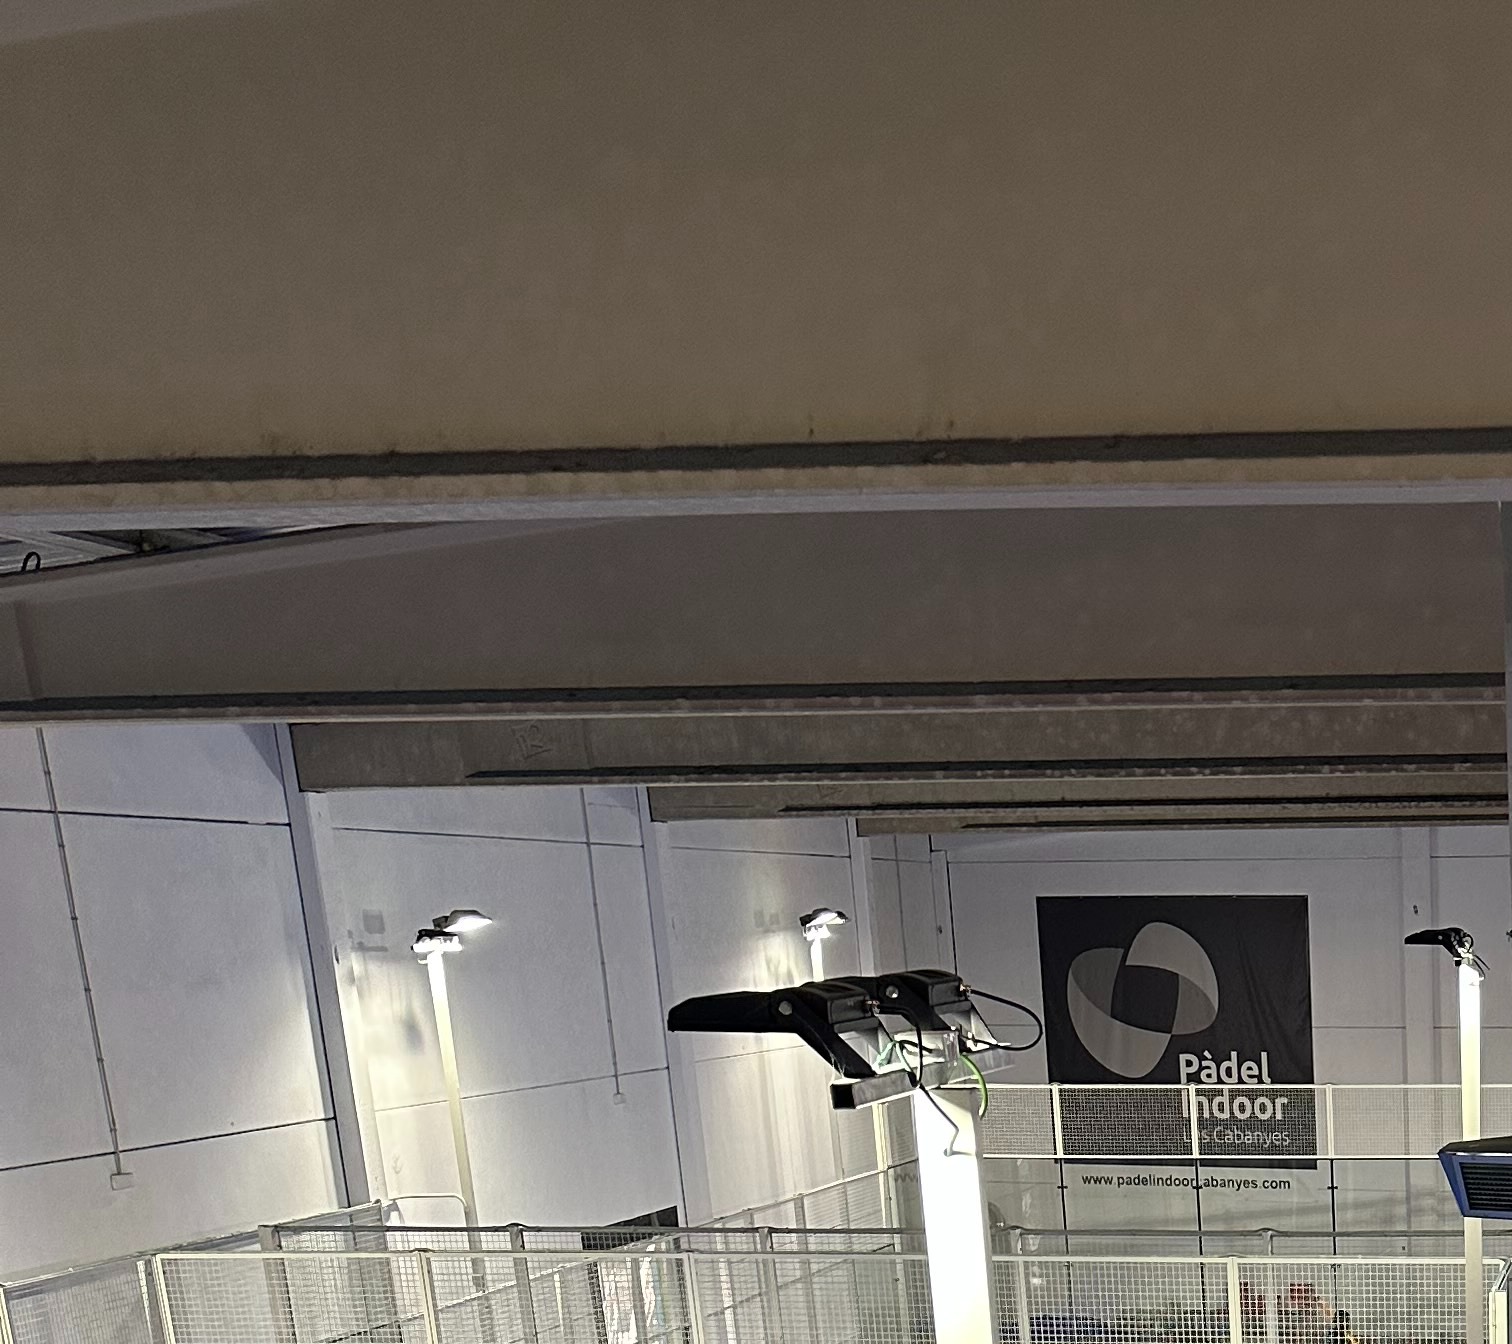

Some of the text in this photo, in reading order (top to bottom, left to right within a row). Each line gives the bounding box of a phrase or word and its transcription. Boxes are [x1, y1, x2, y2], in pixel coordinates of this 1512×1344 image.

[1179, 1050, 1271, 1084] Pàdel
[1181, 1088, 1288, 1119] Indoor
[1182, 1126, 1289, 1147] Ls Cabanyes
[1081, 1174, 1291, 1191] www.padelindoorabanyes.com
